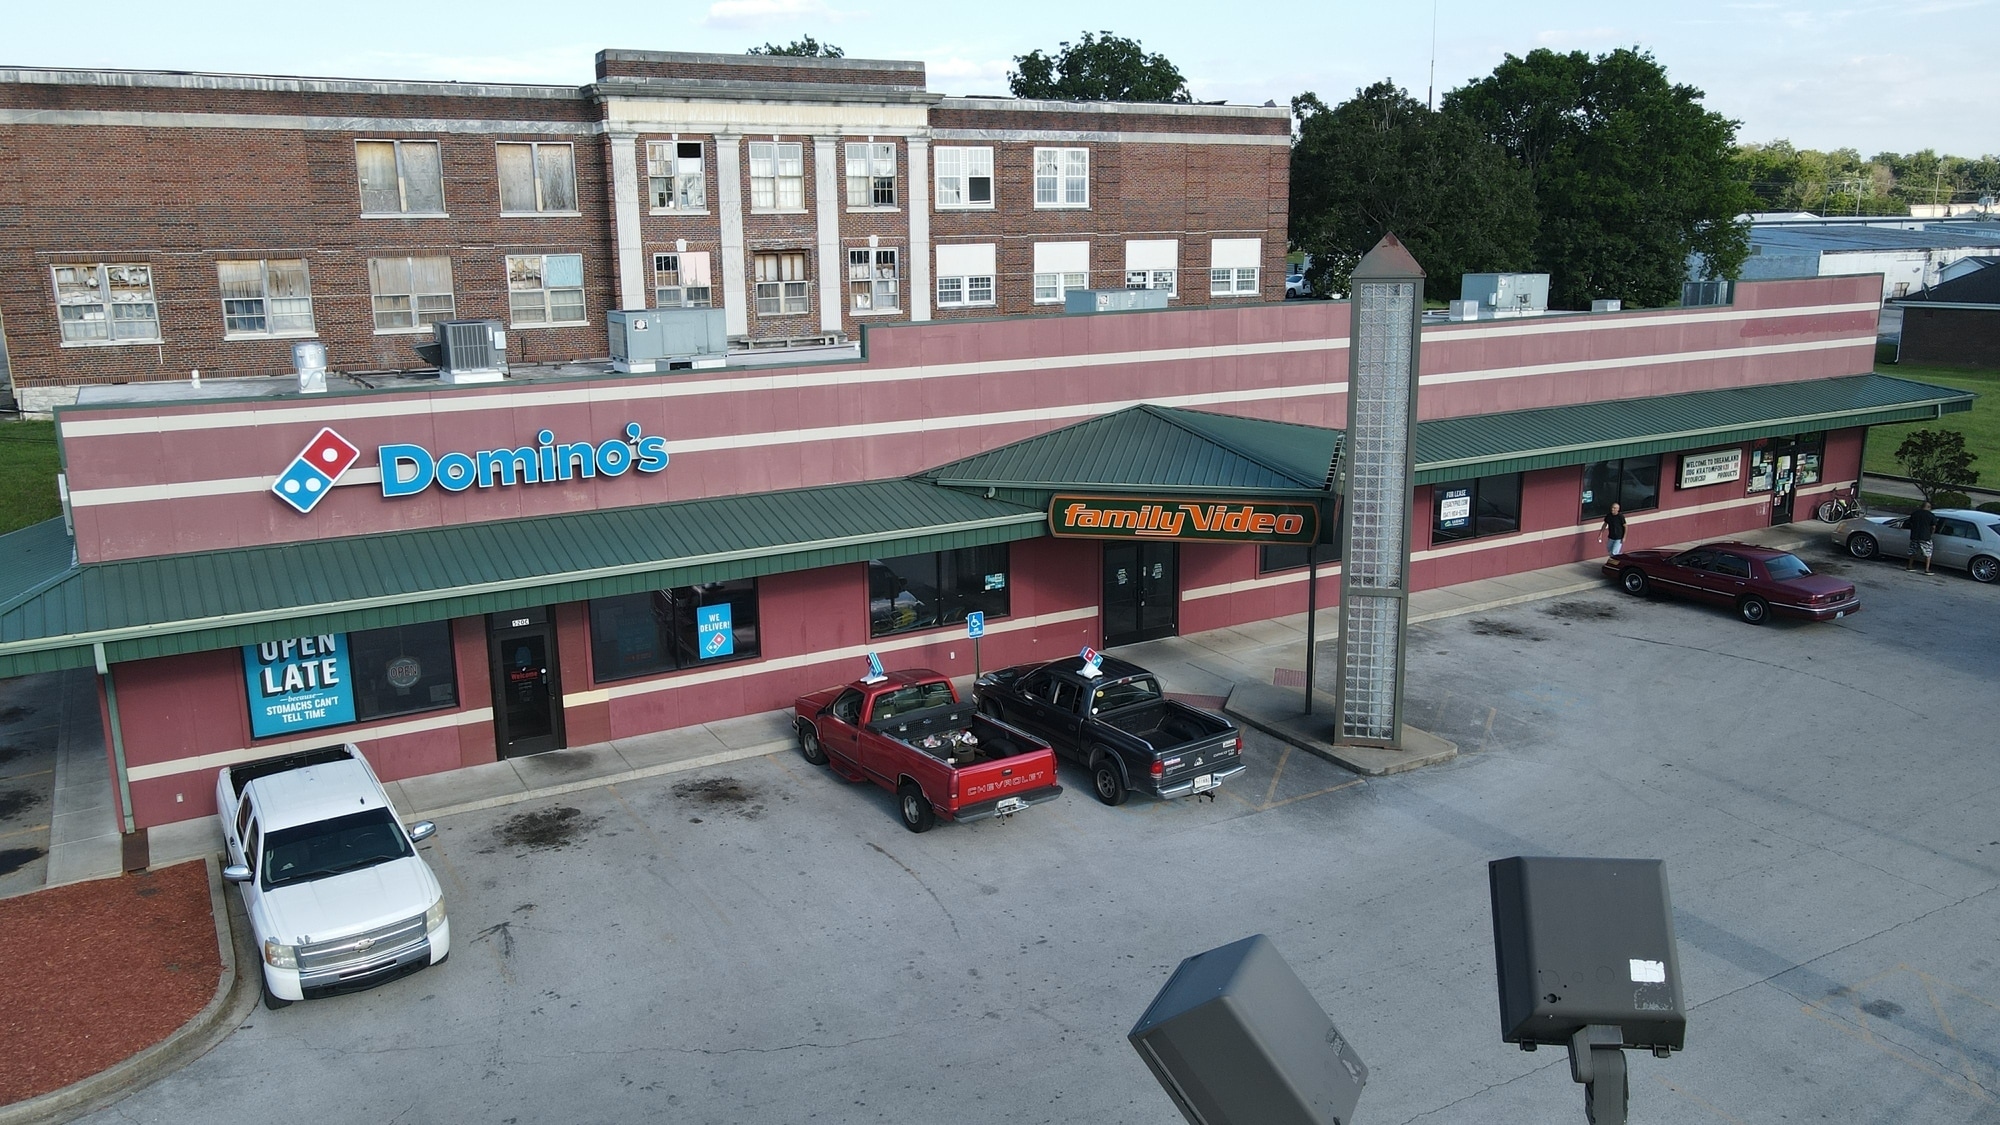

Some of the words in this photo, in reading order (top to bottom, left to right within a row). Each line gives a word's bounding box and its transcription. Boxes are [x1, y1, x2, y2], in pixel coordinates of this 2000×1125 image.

[378, 421, 670, 498] Domino's
[1686, 459, 1706, 468] WELCOME
[1714, 454, 1739, 464] DREAMLAND
[1717, 470, 1738, 479] PRODUCTS
[1455, 489, 1467, 497] LEASE
[1064, 503, 1185, 536] family
[1179, 504, 1304, 534] Video
[708, 613, 720, 622] WE
[700, 620, 730, 632] DELIVER!
[261, 633, 336, 660] OPEN
[264, 658, 339, 693] LATE
[390, 664, 417, 679] OPEN
[287, 693, 317, 702] because
[266, 701, 312, 715] STOMACHS
[315, 696, 338, 707] CAN'T
[282, 714, 303, 723] TELL
[304, 709, 326, 719] TIME
[967, 771, 1043, 796] CHEVROLET
